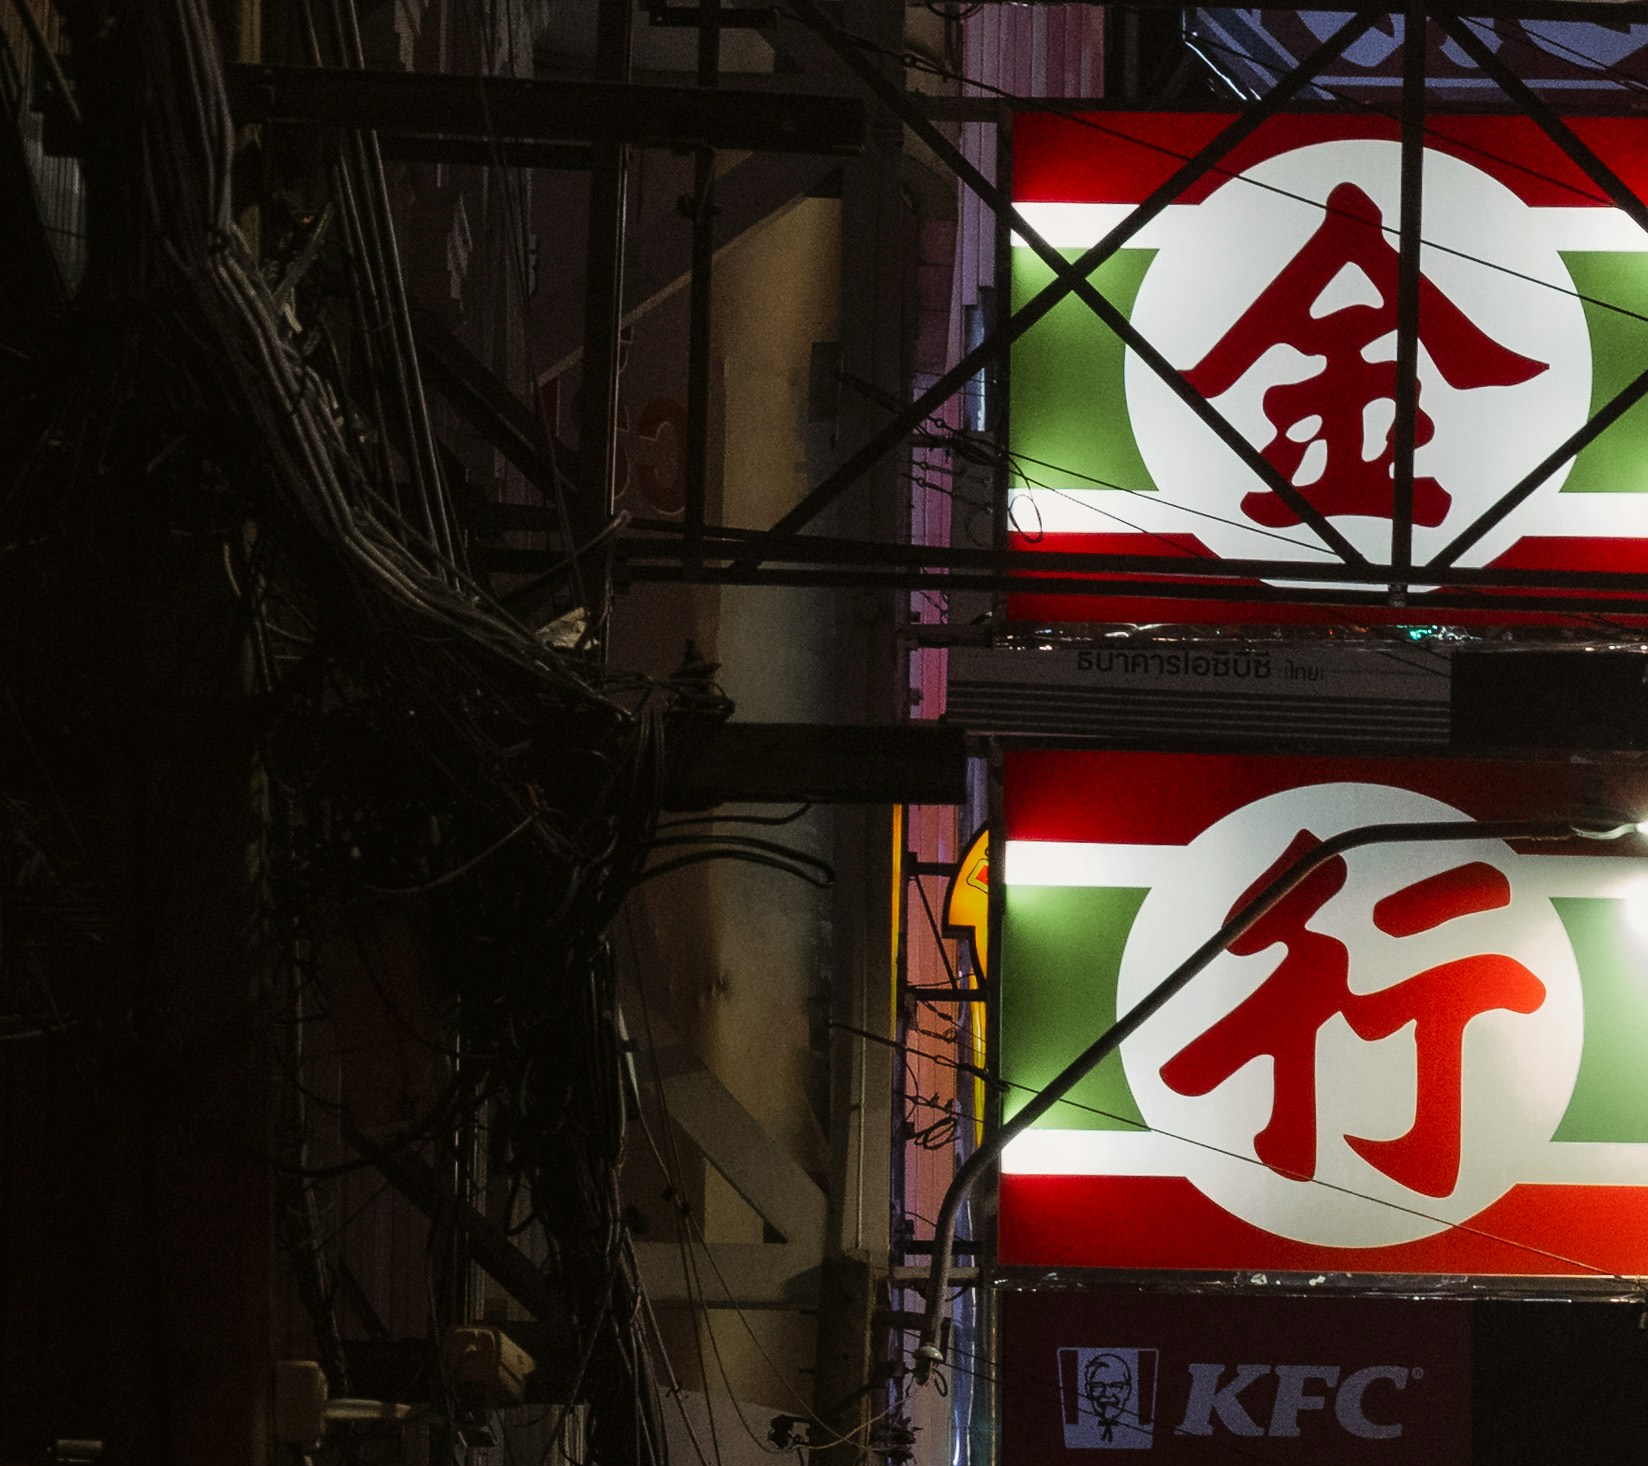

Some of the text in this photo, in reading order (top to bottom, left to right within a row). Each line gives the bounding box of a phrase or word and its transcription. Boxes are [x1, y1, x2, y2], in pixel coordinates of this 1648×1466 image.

[1187, 181, 1548, 528] 金
[1159, 828, 1547, 1198] 行
[1175, 1364, 1408, 1440] KFC
